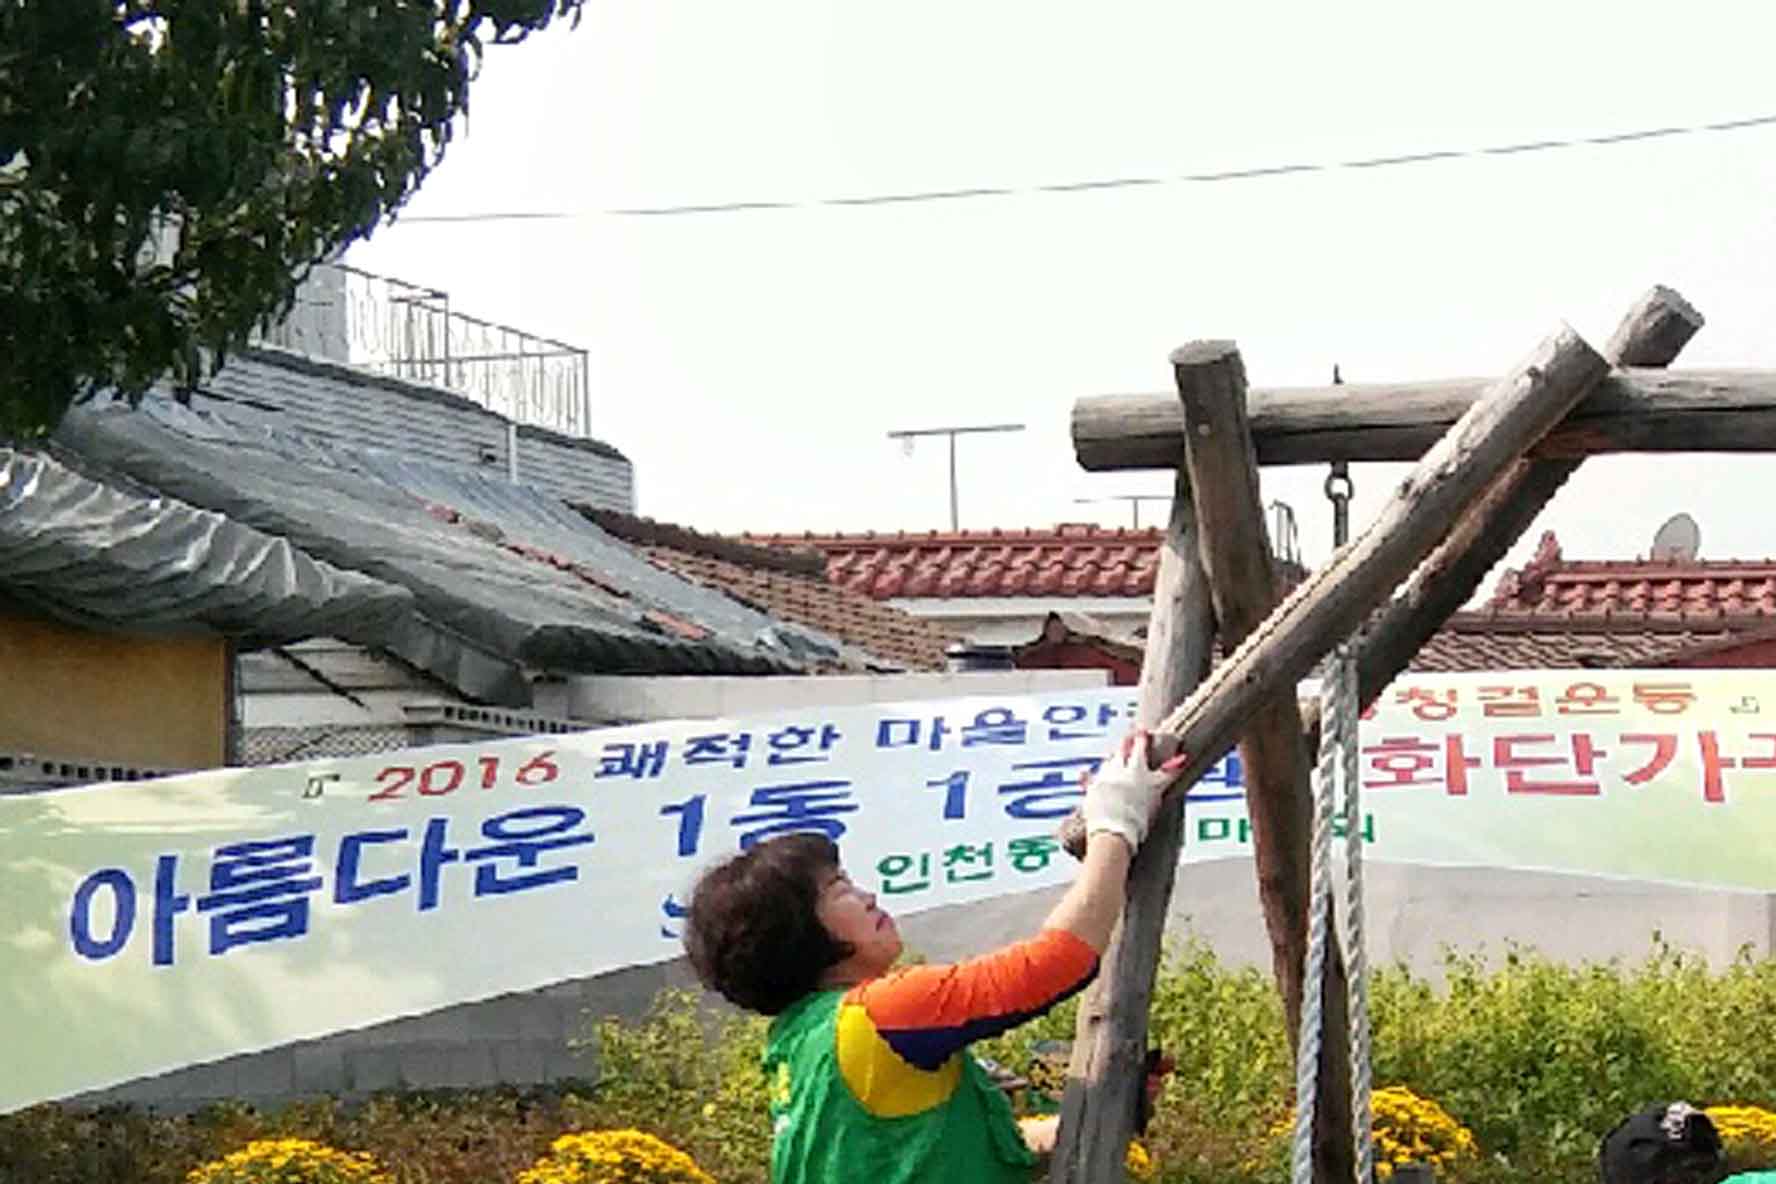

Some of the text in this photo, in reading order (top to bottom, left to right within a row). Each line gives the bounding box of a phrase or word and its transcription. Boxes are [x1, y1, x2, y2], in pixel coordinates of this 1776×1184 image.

[368, 751, 558, 801] 2016
[594, 724, 842, 779] 쾌적한
[876, 702, 1138, 751] 마을안
[1360, 682, 1697, 721] 청결운동
[70, 805, 595, 966] 아름다운
[660, 779, 860, 857] 1동
